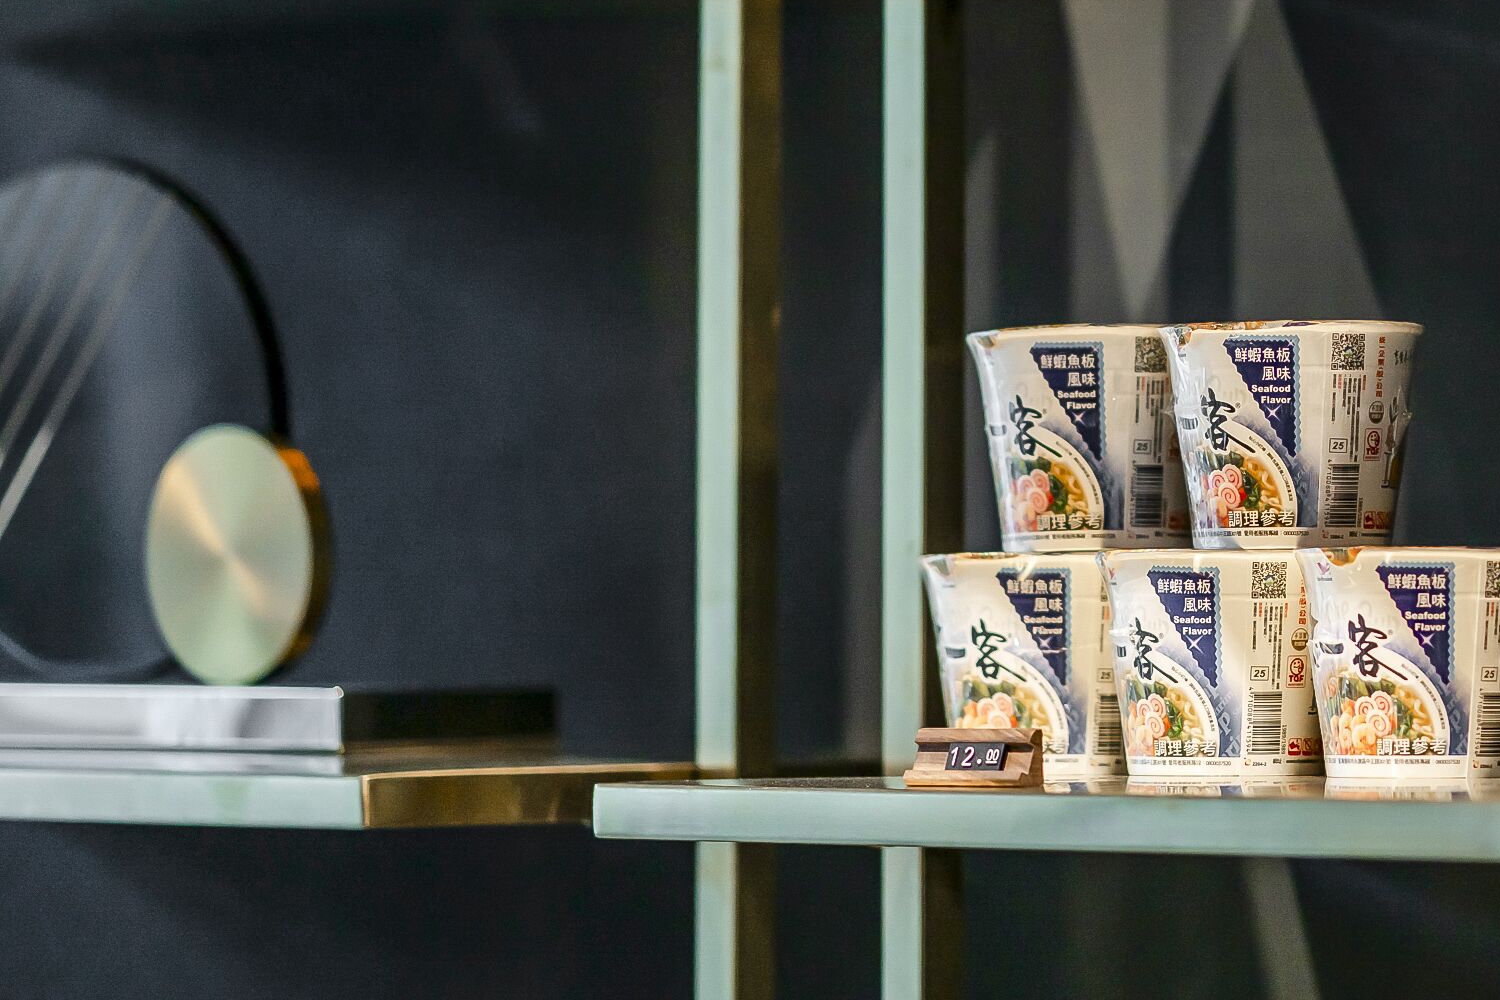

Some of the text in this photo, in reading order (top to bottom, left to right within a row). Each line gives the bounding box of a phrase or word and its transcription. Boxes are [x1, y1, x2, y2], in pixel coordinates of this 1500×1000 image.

[1234, 347, 1291, 363] 鮮蝦魚板
[1041, 354, 1096, 369] 鮮蝦魚板
[1261, 366, 1291, 381] 風味
[1068, 372, 1097, 387] 風味
[1251, 384, 1291, 393] Seafood
[1057, 390, 1097, 398] Seafood
[1261, 395, 1292, 405] Flavor
[1066, 401, 1097, 410] Flavor
[1136, 442, 1148, 451] 25
[1332, 441, 1344, 450] 25
[1228, 510, 1295, 527] 調理參考
[1157, 579, 1212, 594] 鮮蝦魚板
[1387, 573, 1447, 590] 鮮蝦魚板
[1007, 579, 1063, 595] 鮮蝦魚板
[1033, 598, 1064, 613] 風味
[1183, 598, 1212, 613] 風味
[1416, 593, 1447, 608] 風味
[1023, 615, 1063, 624] Seafood
[1173, 615, 1212, 624] Seafood
[1404, 611, 1446, 620] Seafood
[1032, 626, 1063, 635] Flavor
[1182, 627, 1213, 636] Flavor
[1414, 622, 1447, 632] Flavor
[1253, 669, 1266, 678] 25
[1288, 674, 1304, 683] TQF
[1483, 670, 1495, 679] 25
[1154, 739, 1217, 757] 調理參考
[1377, 738, 1447, 755] 調理參考
[950, 746, 1000, 768] 12.00
